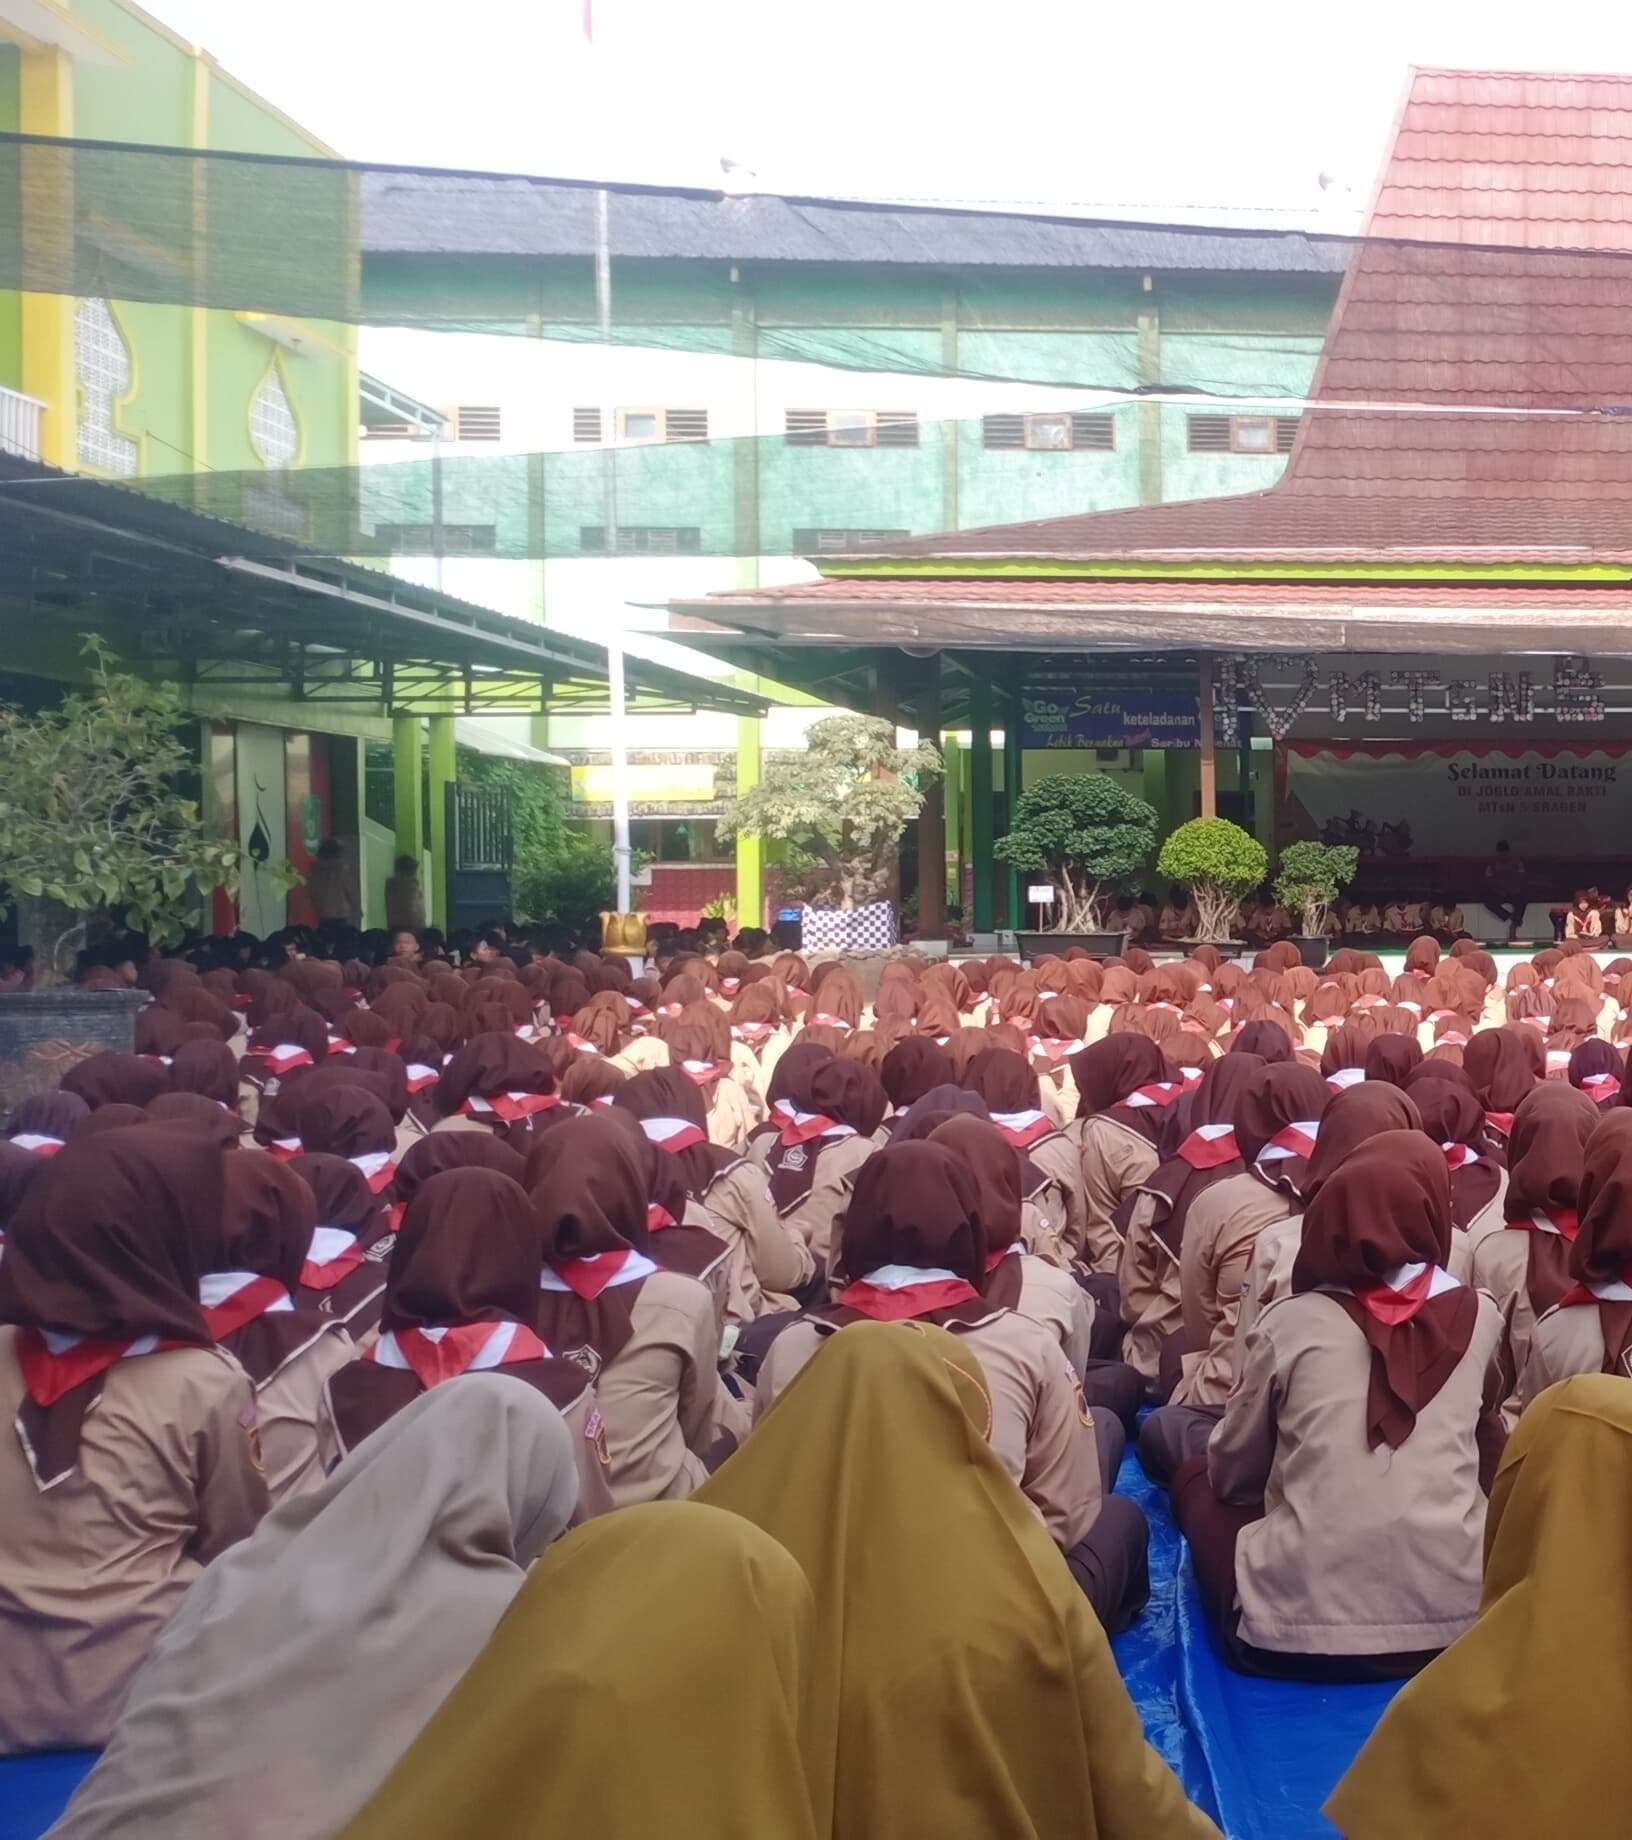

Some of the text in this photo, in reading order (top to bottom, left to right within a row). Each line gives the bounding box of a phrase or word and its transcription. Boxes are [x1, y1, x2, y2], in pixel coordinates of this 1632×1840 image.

[1123, 712, 1195, 727] keteladanan
[1447, 763, 1617, 783] Selamat Datang
[1476, 786, 1520, 797] JOGLO
[1523, 786, 1563, 797] AMAL
